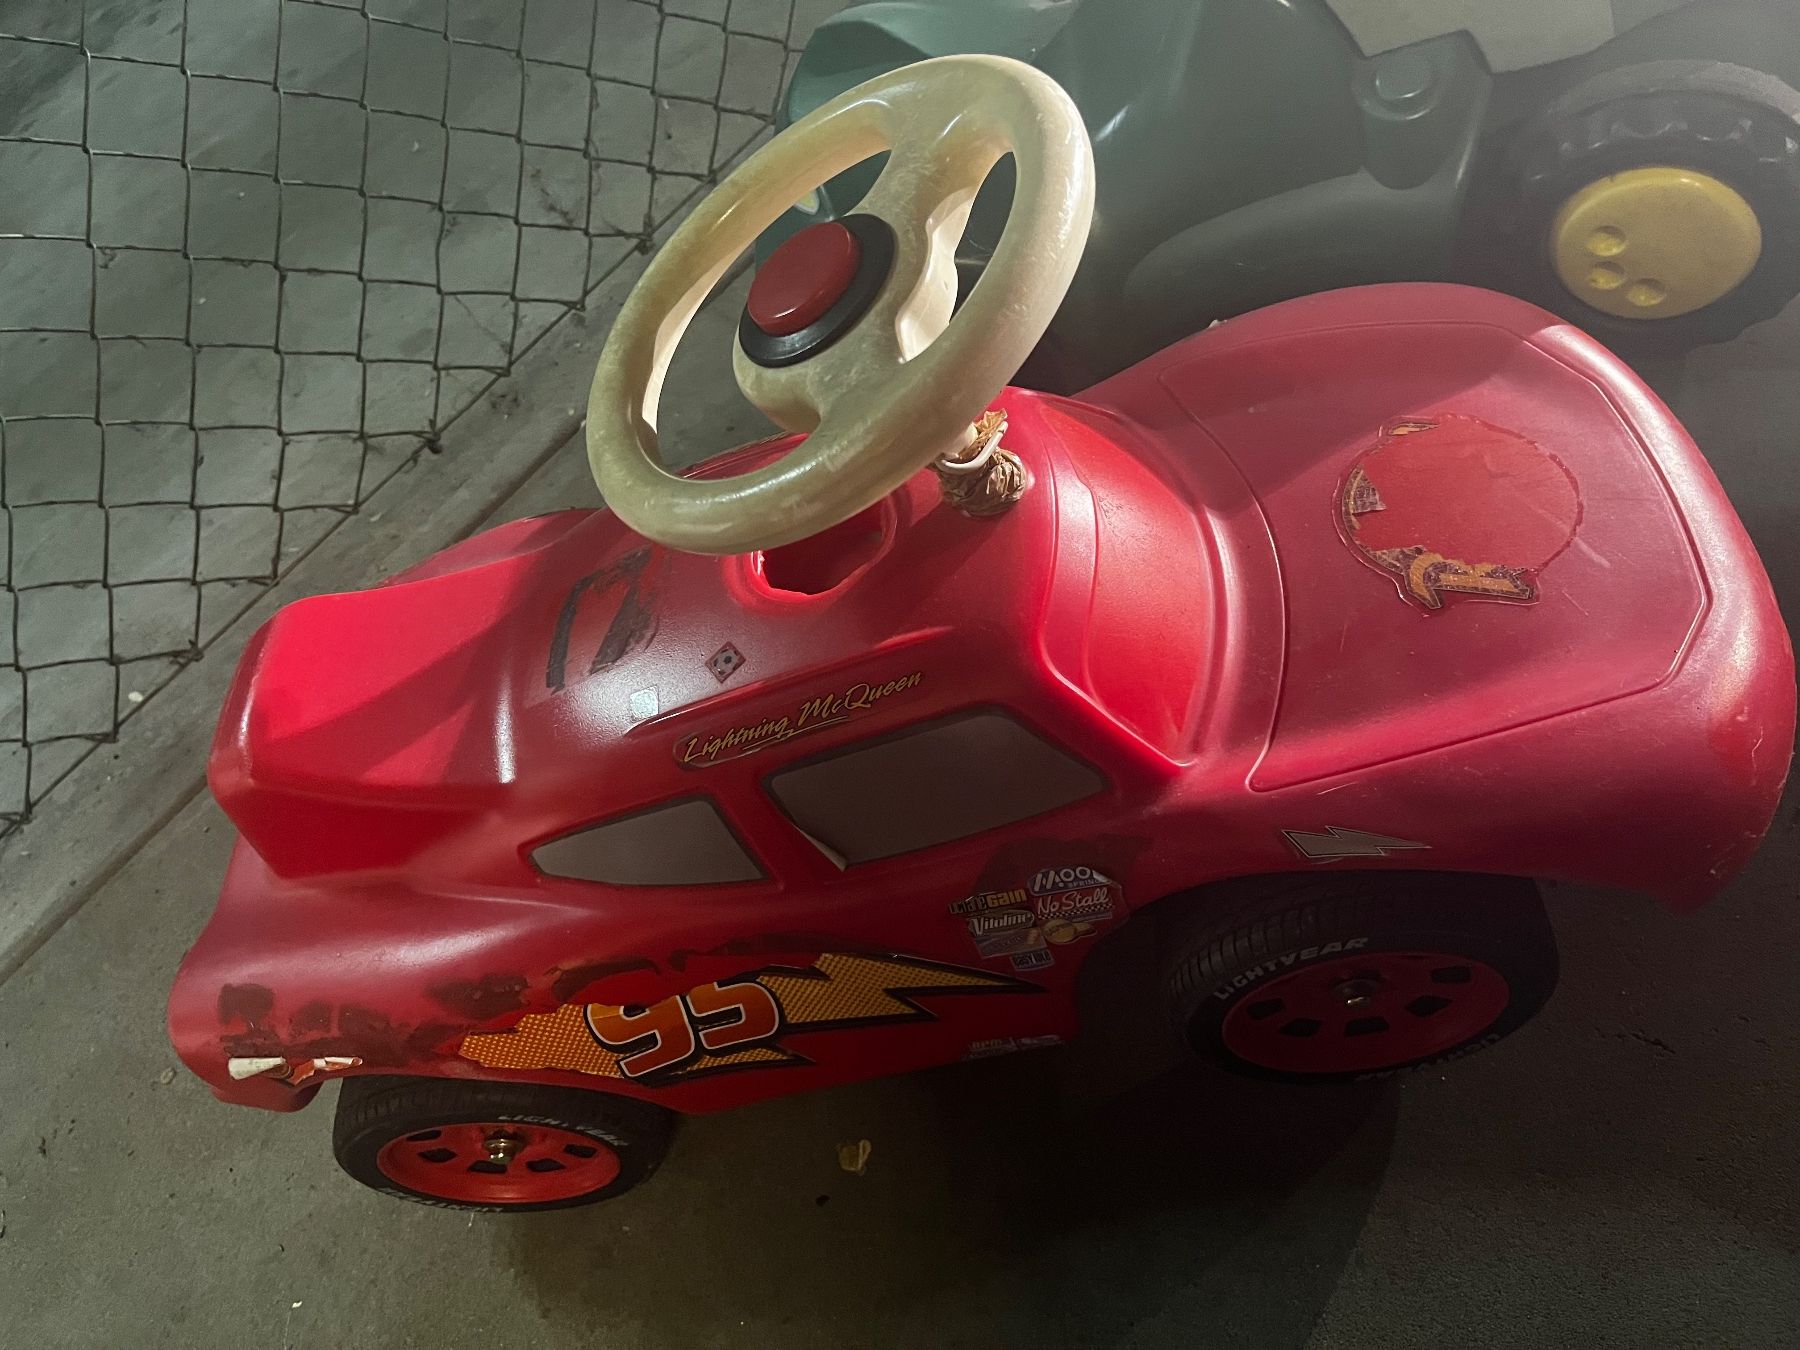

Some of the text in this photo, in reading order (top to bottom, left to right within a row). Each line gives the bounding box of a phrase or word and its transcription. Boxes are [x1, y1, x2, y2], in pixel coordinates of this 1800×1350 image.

[683, 671, 922, 763] Lightning McQueen
[1037, 887, 1111, 915] No Stall
[1213, 937, 1368, 1000] LIGHTYEAR
[586, 981, 780, 1078] 95
